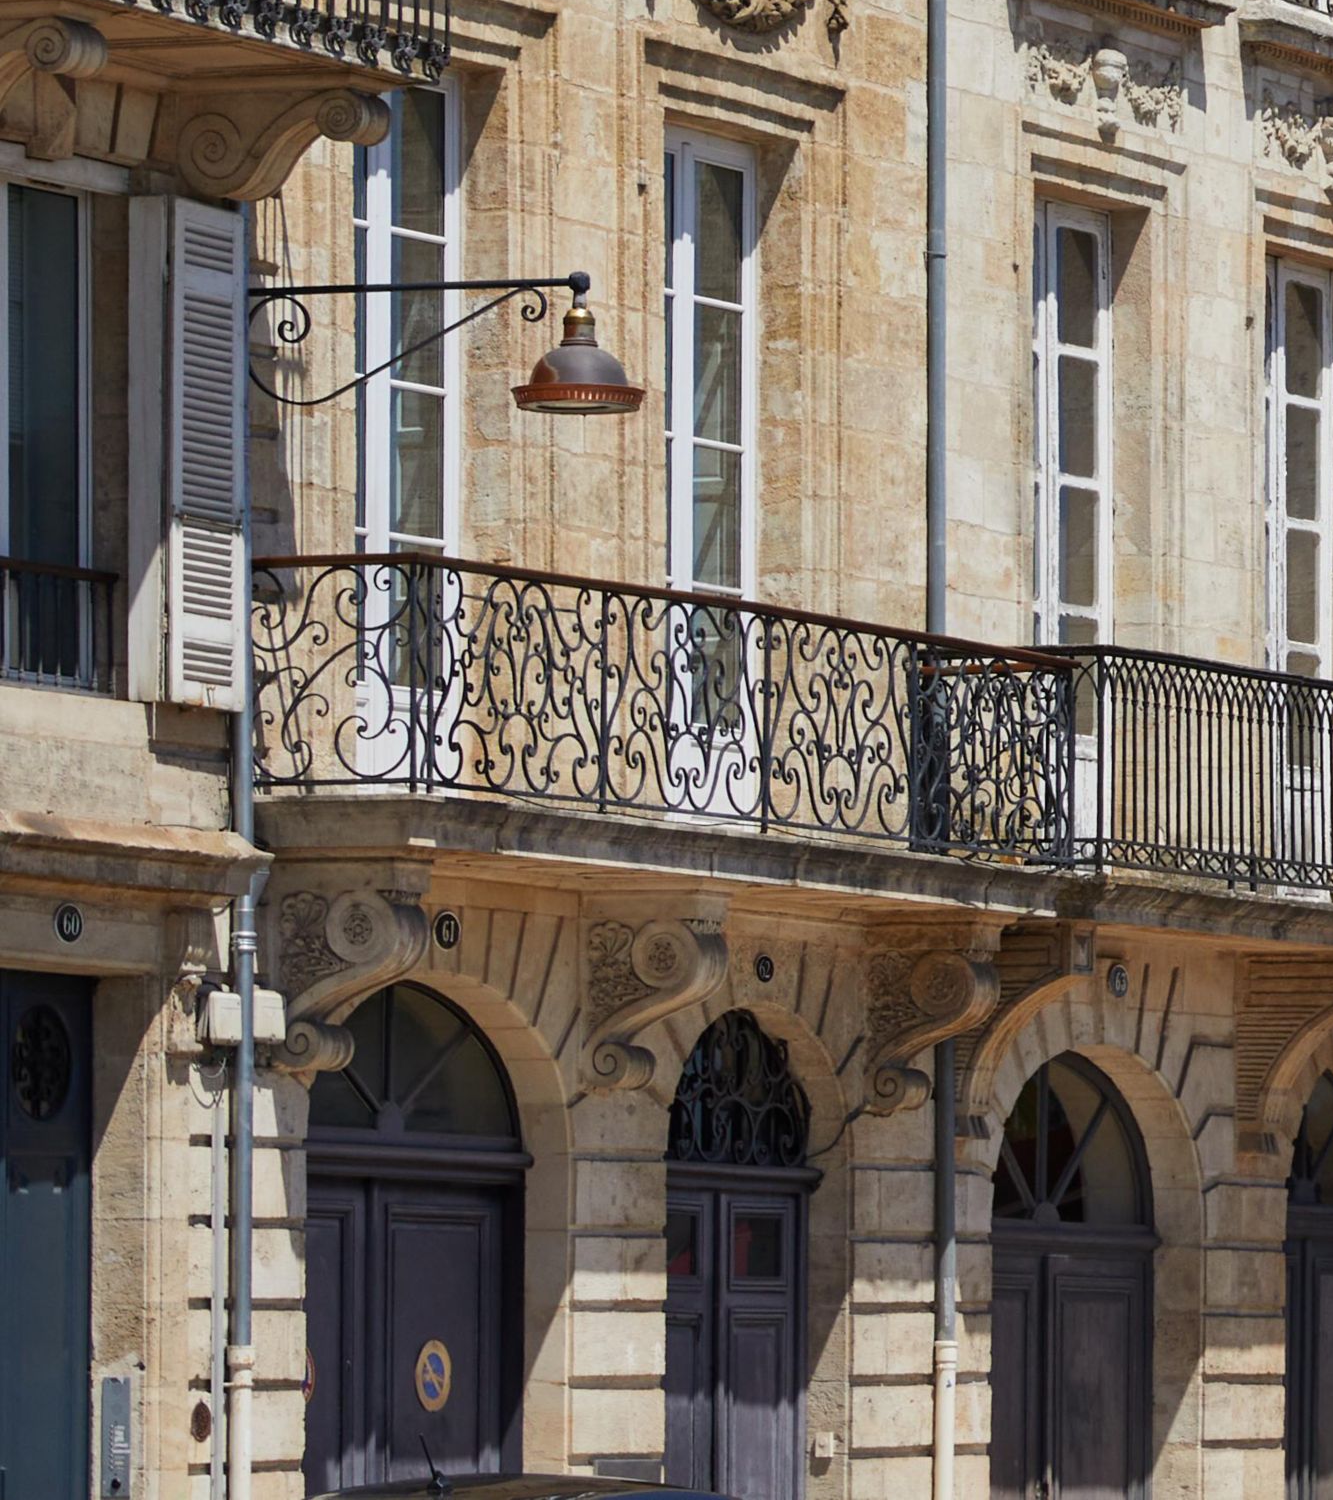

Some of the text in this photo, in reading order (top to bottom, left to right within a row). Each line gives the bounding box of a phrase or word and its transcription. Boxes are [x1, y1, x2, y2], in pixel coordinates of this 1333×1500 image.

[63, 912, 80, 936] 60
[442, 920, 455, 943] 61
[760, 958, 771, 979] 62
